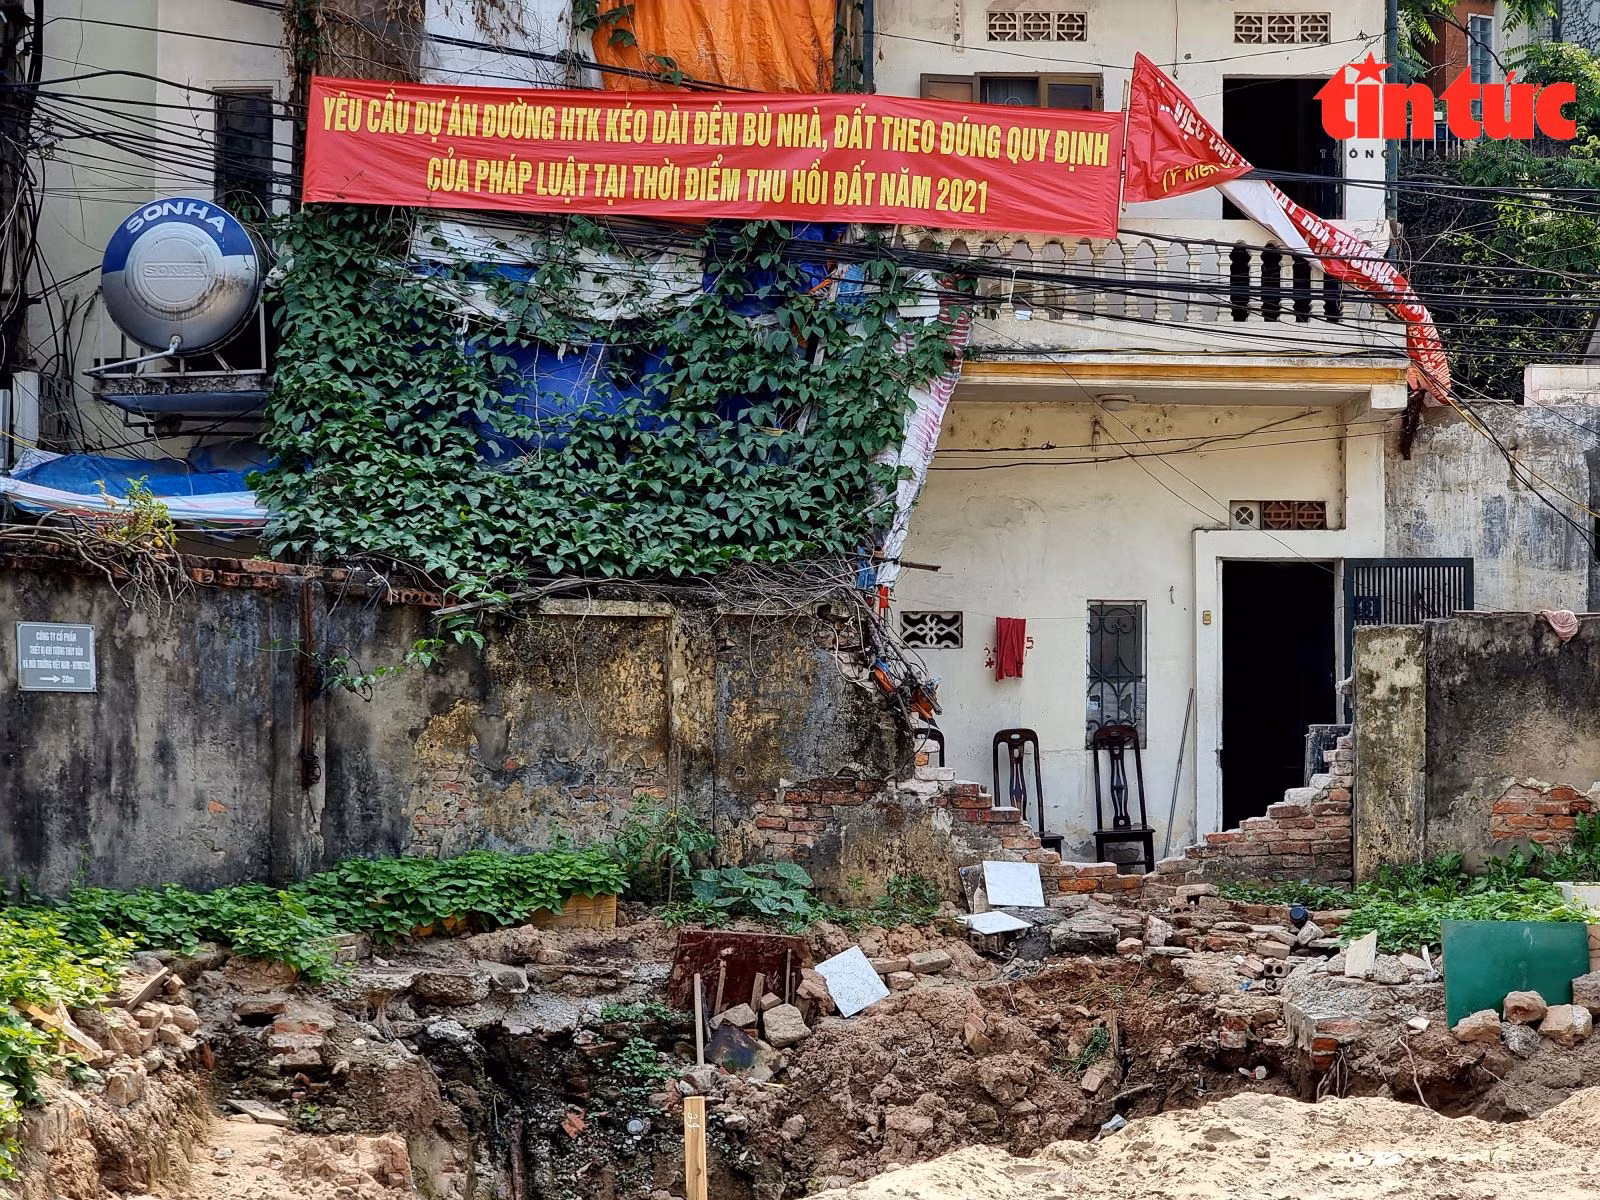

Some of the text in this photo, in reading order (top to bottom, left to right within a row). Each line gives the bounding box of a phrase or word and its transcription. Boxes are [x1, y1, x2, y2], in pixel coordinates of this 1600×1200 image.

[323, 88, 1110, 172] YÊU CẦU DỰ ÁN ĐƯỜNG HTK KÉO DÀI ĐỀN BÙ NHÀ, ĐẤT THEO ĐÚNG QUY ĐỊNH
[427, 146, 989, 214] CỦA PHÁP LUẬT TẠI THỜI ĐIỂM THU HỒI ĐẤT NĂM 2021
[126, 201, 226, 233] SONHA
